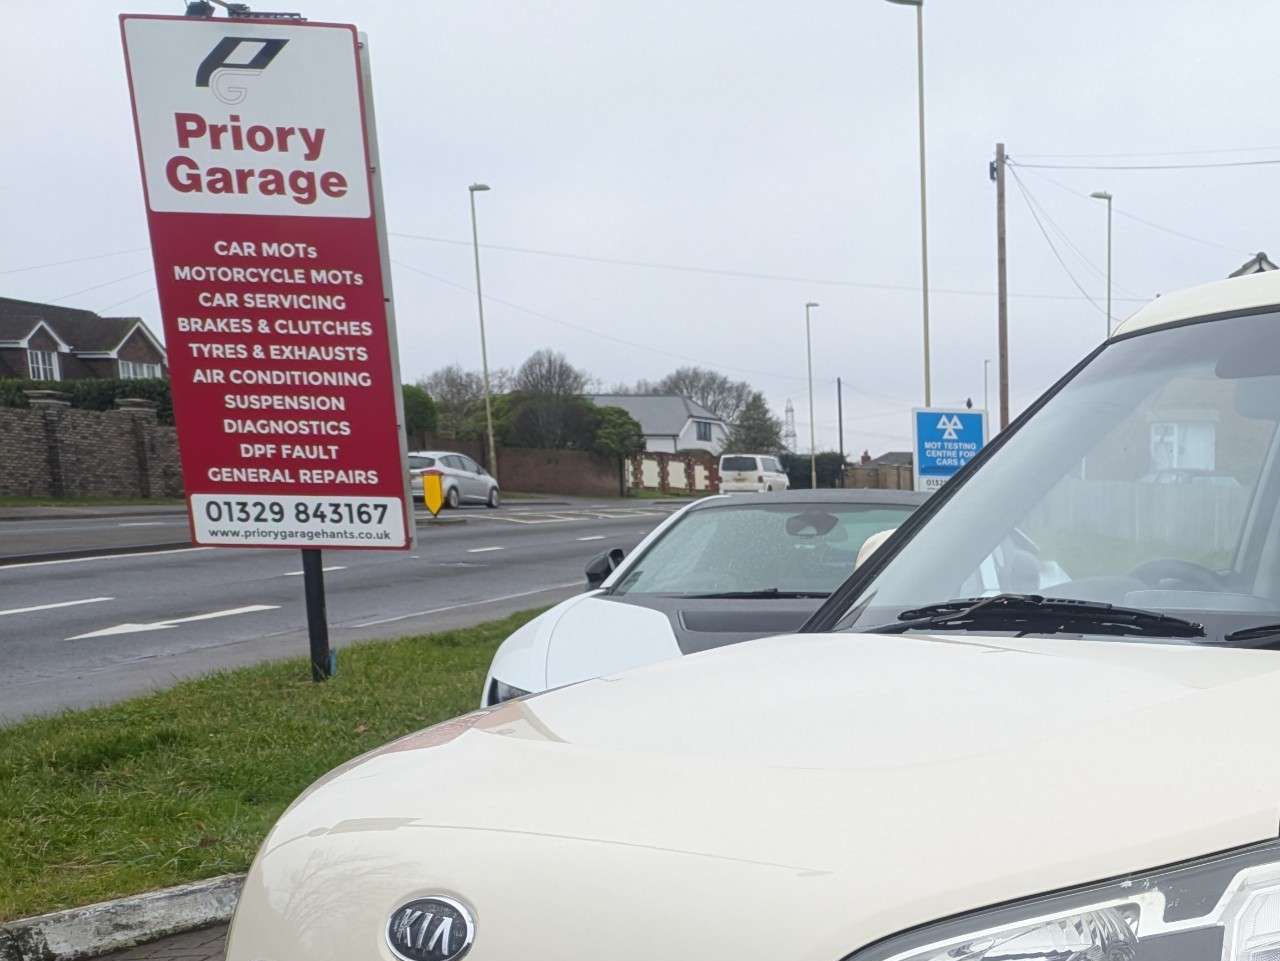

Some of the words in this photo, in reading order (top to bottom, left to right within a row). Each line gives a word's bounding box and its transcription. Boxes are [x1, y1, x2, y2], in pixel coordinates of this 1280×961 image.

[174, 112, 326, 161] Priory
[165, 155, 348, 204] Garage
[213, 240, 256, 257] CAR
[261, 242, 318, 259] MOTs
[173, 265, 306, 284] MOTORCYCLE
[310, 269, 364, 286] MOTs
[198, 292, 239, 308] CAR
[243, 293, 346, 311] SERVICING
[177, 317, 253, 334] BRAKES
[257, 318, 271, 334] &
[274, 320, 373, 337] CLUTCHES
[188, 343, 249, 359] TYRES
[252, 344, 266, 359] &
[269, 345, 369, 362] EXHAUSTS
[192, 368, 226, 384] AIR
[229, 369, 372, 387] CONDITIONING
[224, 394, 346, 411] SUSPENSION
[223, 418, 351, 436] DIAGNOSTICS
[239, 443, 278, 458] DPF
[280, 444, 339, 460] FAULT
[926, 450, 957, 458] CENTRE
[944, 442, 976, 450] TESTING
[936, 458, 958, 466] CARS
[207, 467, 296, 483] GENERAL
[298, 469, 379, 485] REPAIRS
[205, 501, 285, 523] 01329
[294, 502, 388, 525] 843167
[208, 528, 391, 541] www.priorygaragehants.co.uk
[397, 908, 453, 956] KIA
